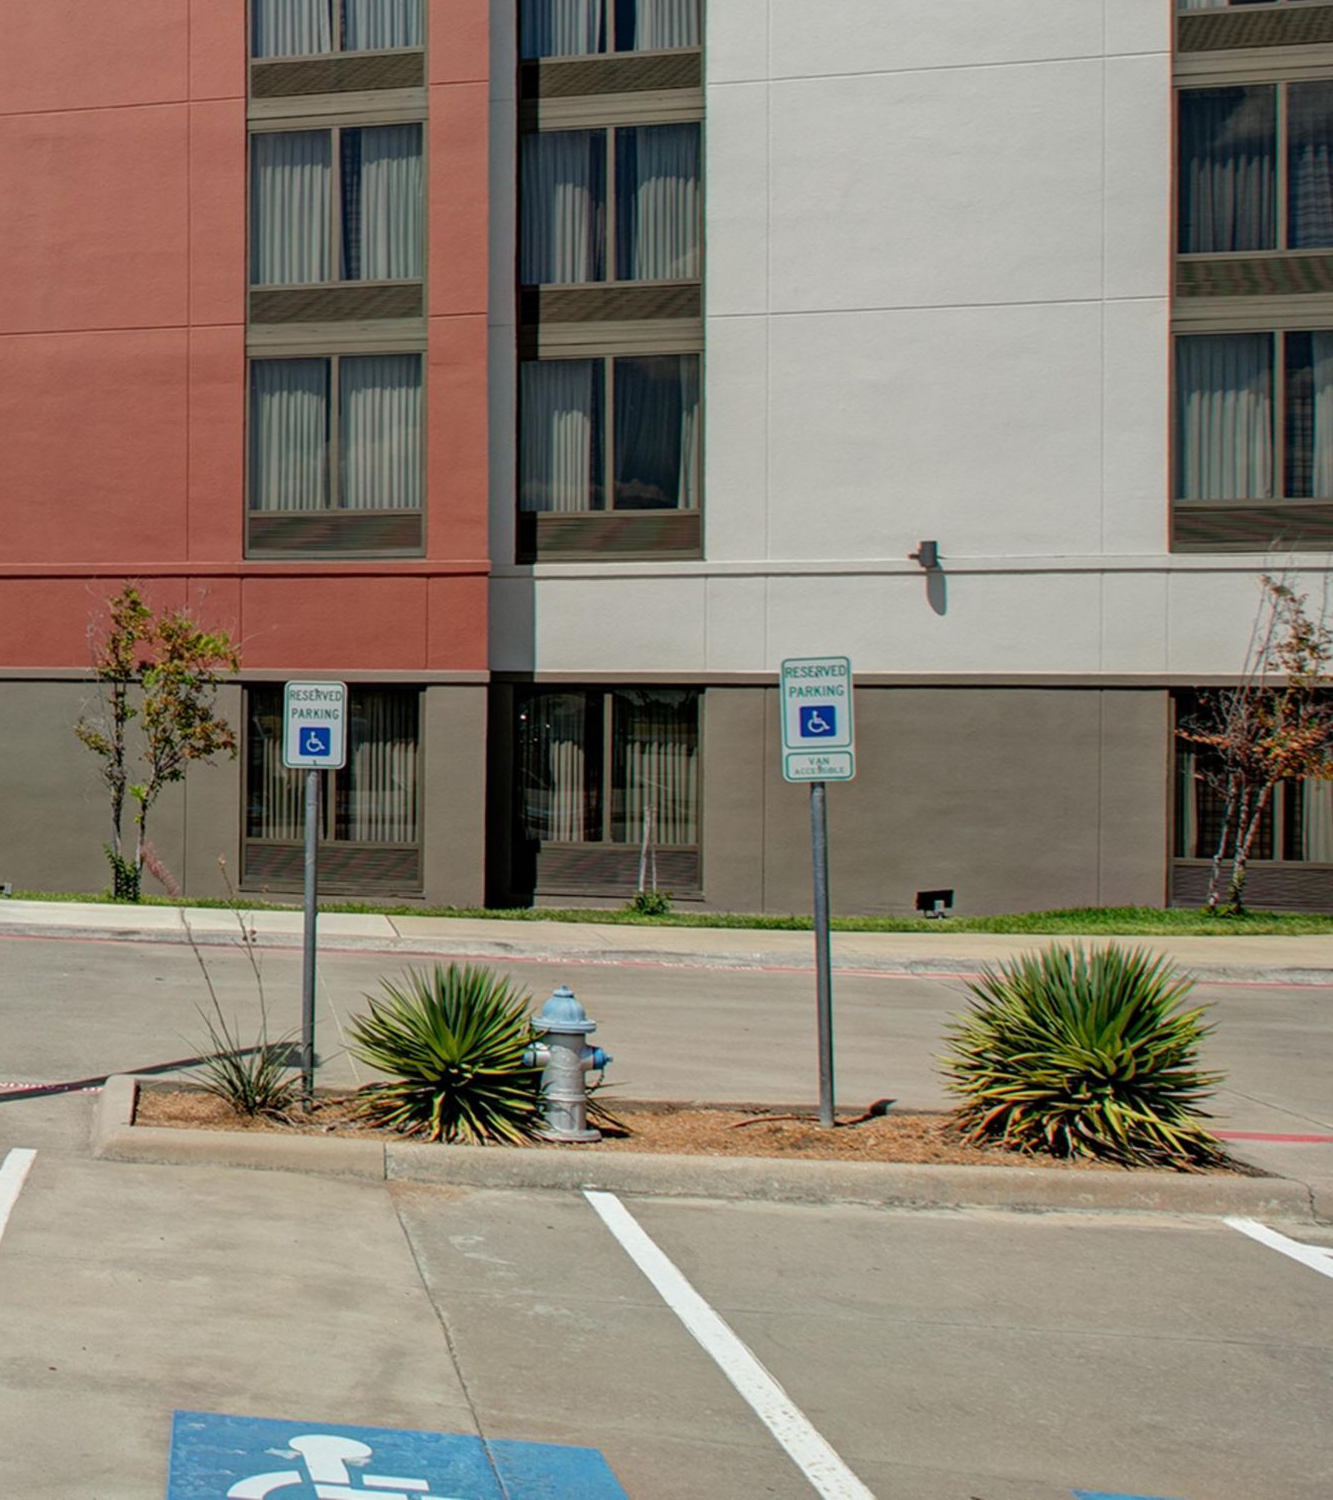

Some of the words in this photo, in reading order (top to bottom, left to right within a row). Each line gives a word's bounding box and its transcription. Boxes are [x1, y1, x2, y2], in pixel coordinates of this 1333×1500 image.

[785, 664, 846, 678] RESERVED
[290, 690, 342, 701] RESERVED
[789, 684, 844, 698] PARKING
[291, 708, 339, 720] PARKING
[808, 757, 830, 765] VAN
